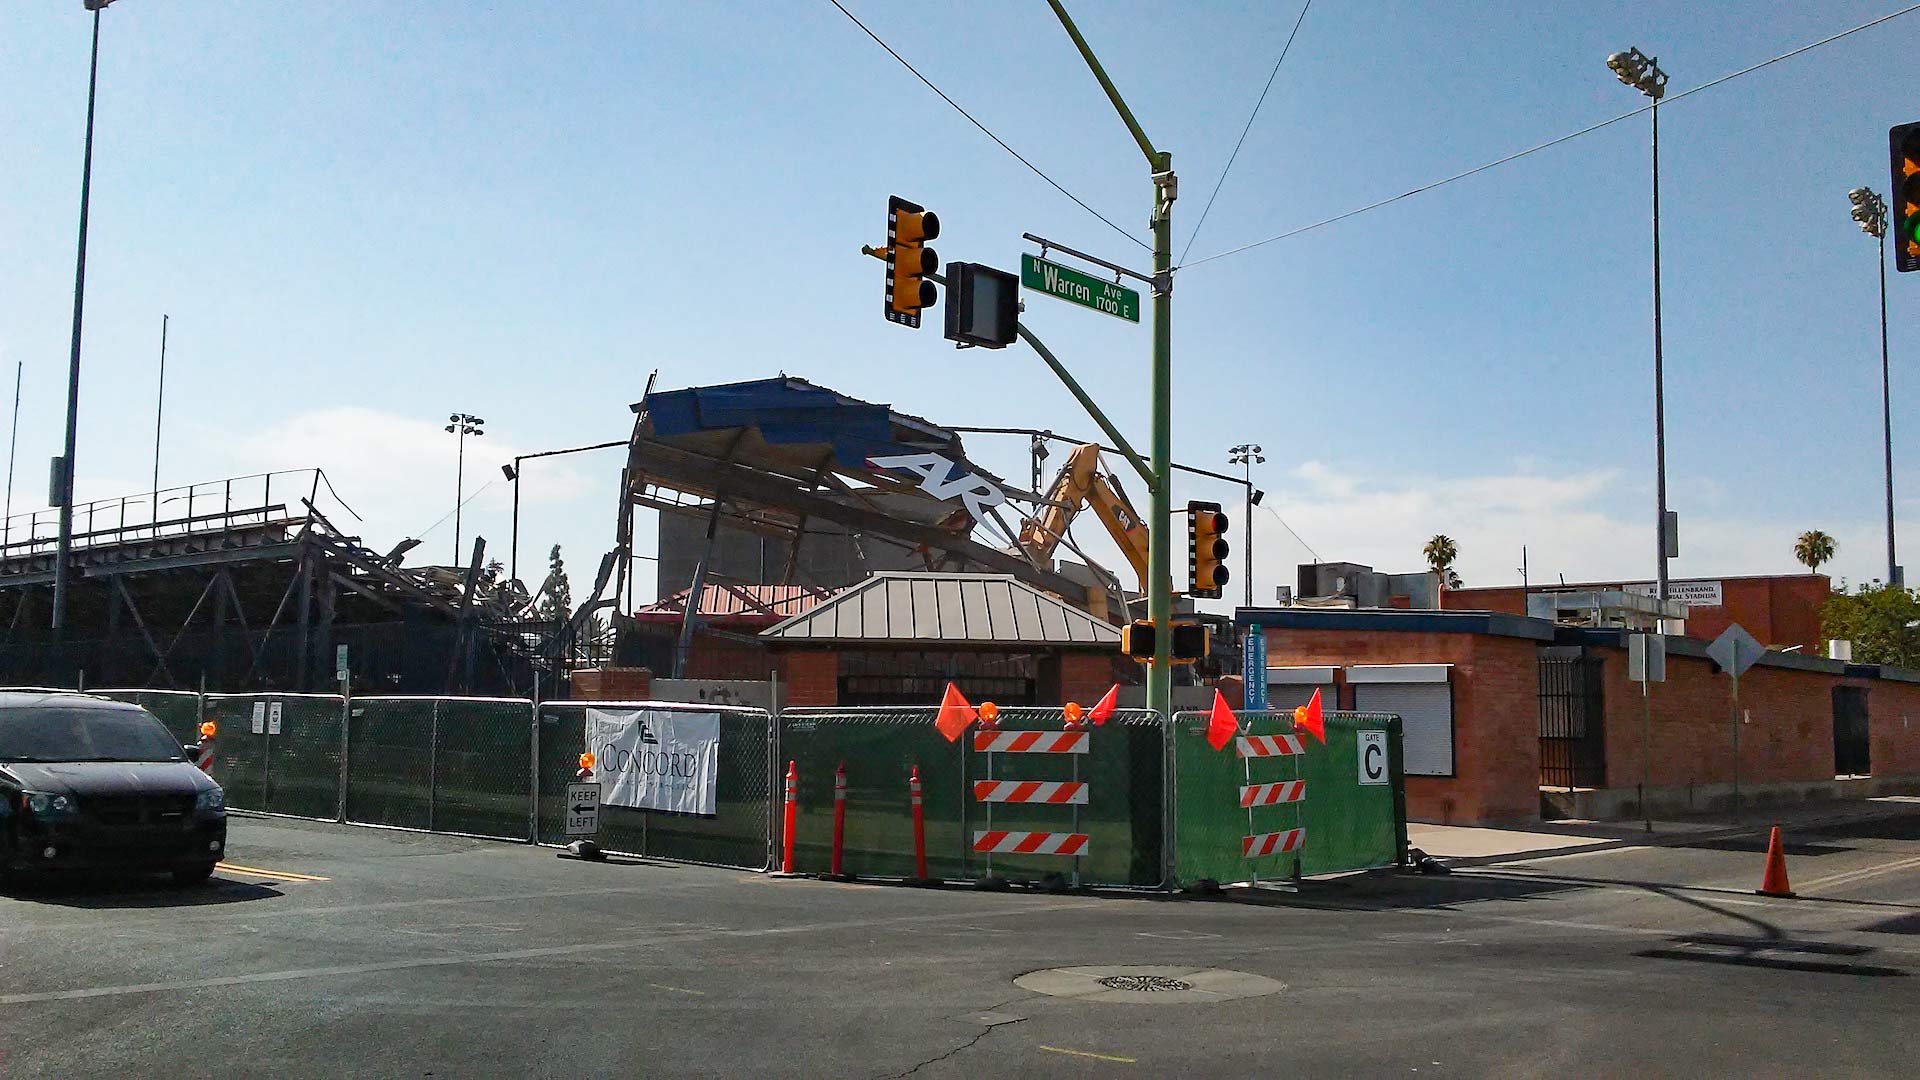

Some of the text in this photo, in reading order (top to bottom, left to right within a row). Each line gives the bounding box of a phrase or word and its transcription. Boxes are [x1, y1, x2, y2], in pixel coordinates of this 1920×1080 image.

[1033, 259, 1123, 302] N Warren Ave
[1096, 295, 1130, 318] 1700 E
[1685, 592, 1717, 600] STADIUM
[1247, 637, 1256, 704] EMERGENCY
[1365, 733, 1380, 742] GATE
[602, 743, 697, 778] CONCORD
[1364, 743, 1382, 780] C
[571, 791, 597, 801] KEEP
[570, 816, 595, 828] LEFT
